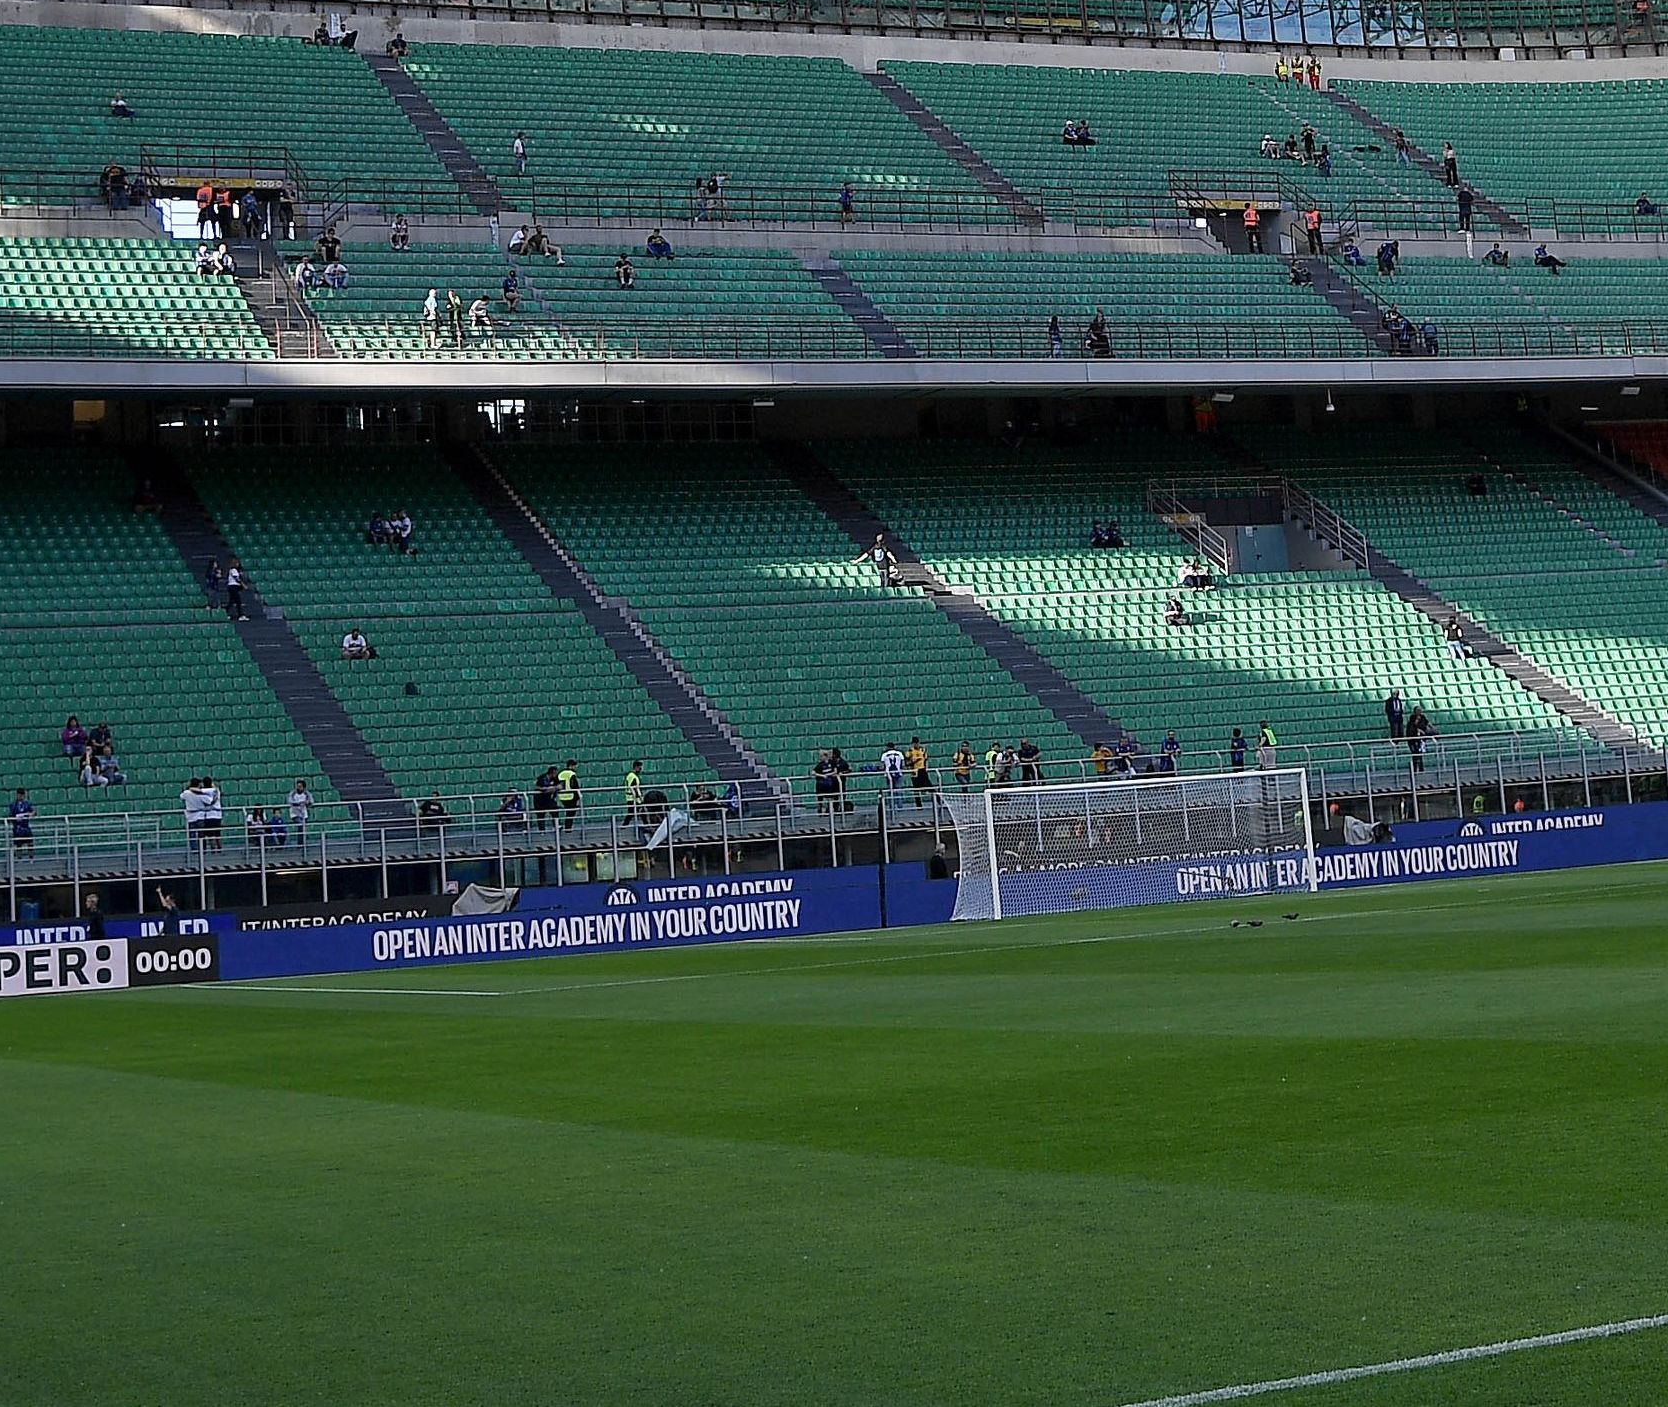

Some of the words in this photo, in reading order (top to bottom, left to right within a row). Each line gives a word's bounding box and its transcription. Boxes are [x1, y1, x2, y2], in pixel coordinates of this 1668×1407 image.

[1176, 864, 1222, 894] OPEN
[1224, 863, 1249, 890] AN
[1381, 849, 1400, 877] IN
[1401, 846, 1446, 874] YOUR
[1448, 840, 1519, 872] COUNTRY
[373, 927, 430, 961] OPEN
[433, 924, 465, 957] AN
[466, 920, 526, 953] INTER
[528, 912, 626, 949] ACADEMY
[630, 911, 650, 941] IN
[654, 907, 707, 939] YOUR
[710, 899, 801, 935] COUNTRY
[136, 947, 212, 974] 00:00
